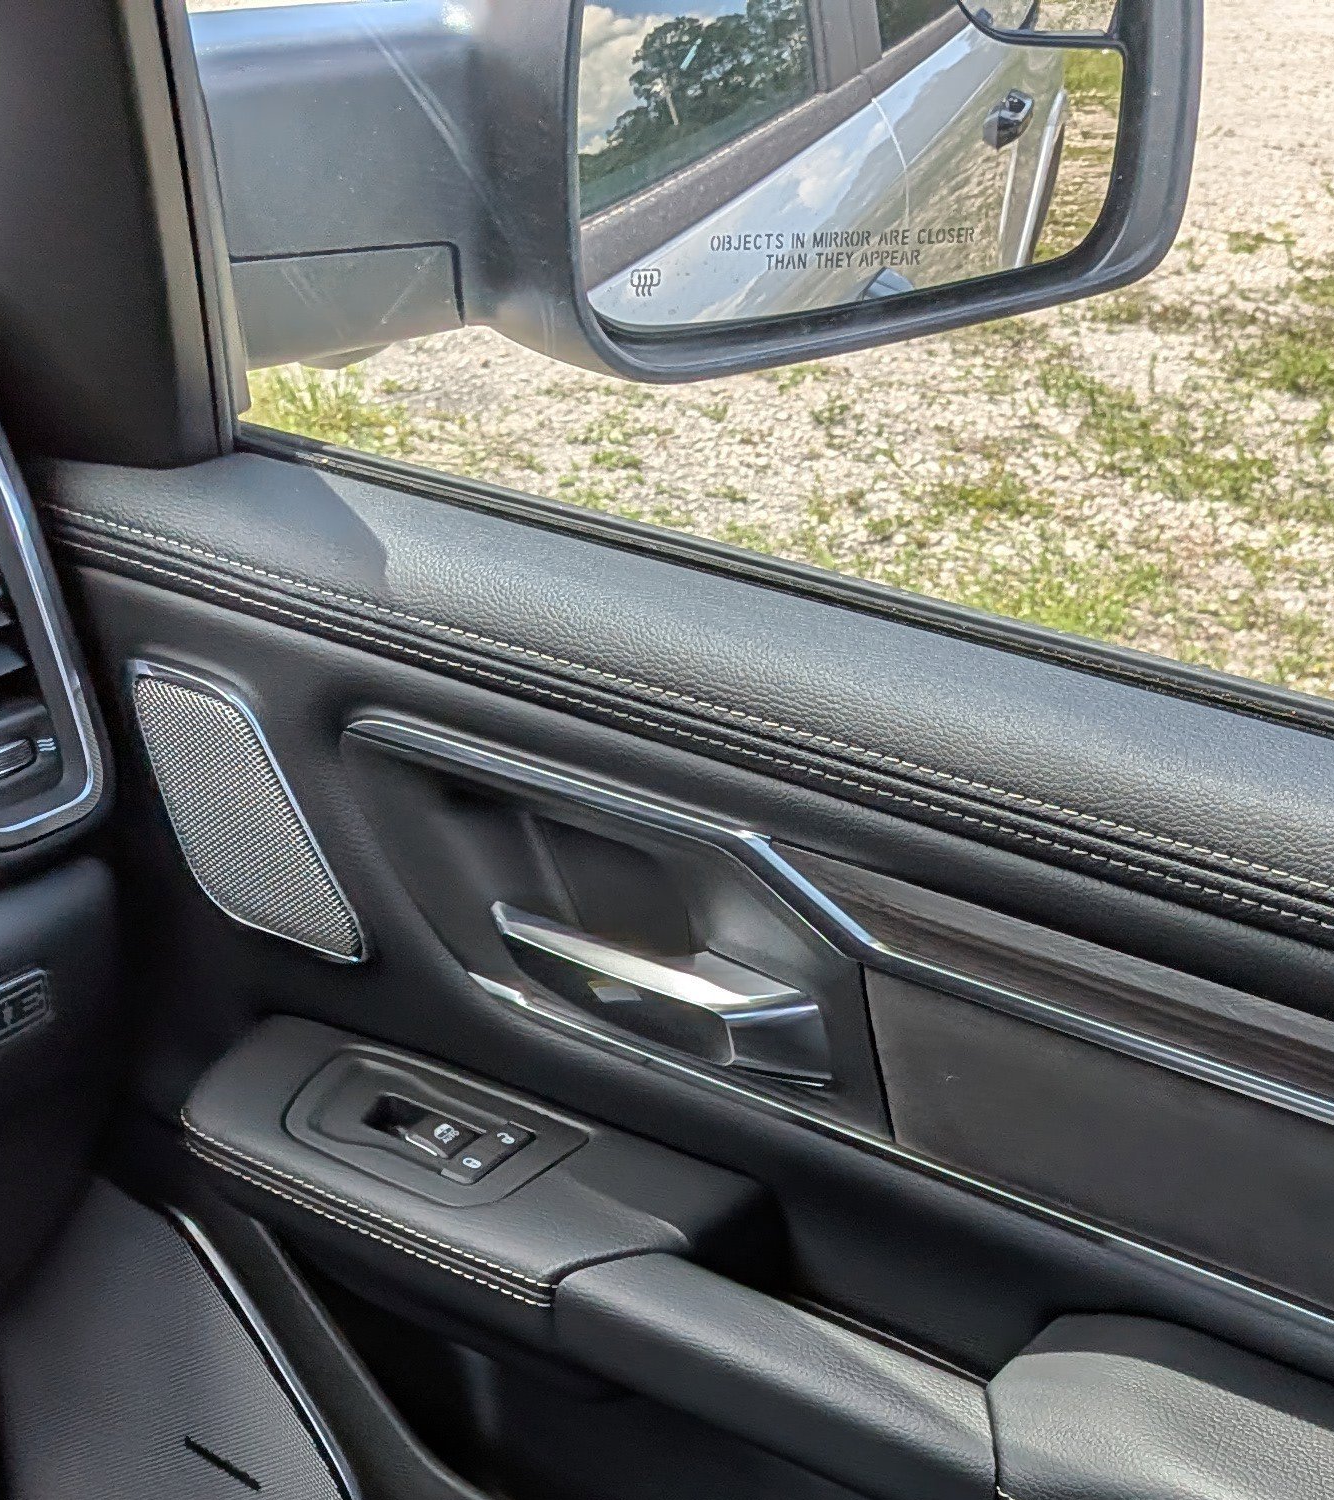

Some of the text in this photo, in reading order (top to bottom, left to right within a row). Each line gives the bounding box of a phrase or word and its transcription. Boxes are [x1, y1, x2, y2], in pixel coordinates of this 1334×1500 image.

[710, 226, 975, 251] OBJECTS IN MIRROR ARE CLOSER
[766, 250, 921, 270] THAN THEY APPEAR
